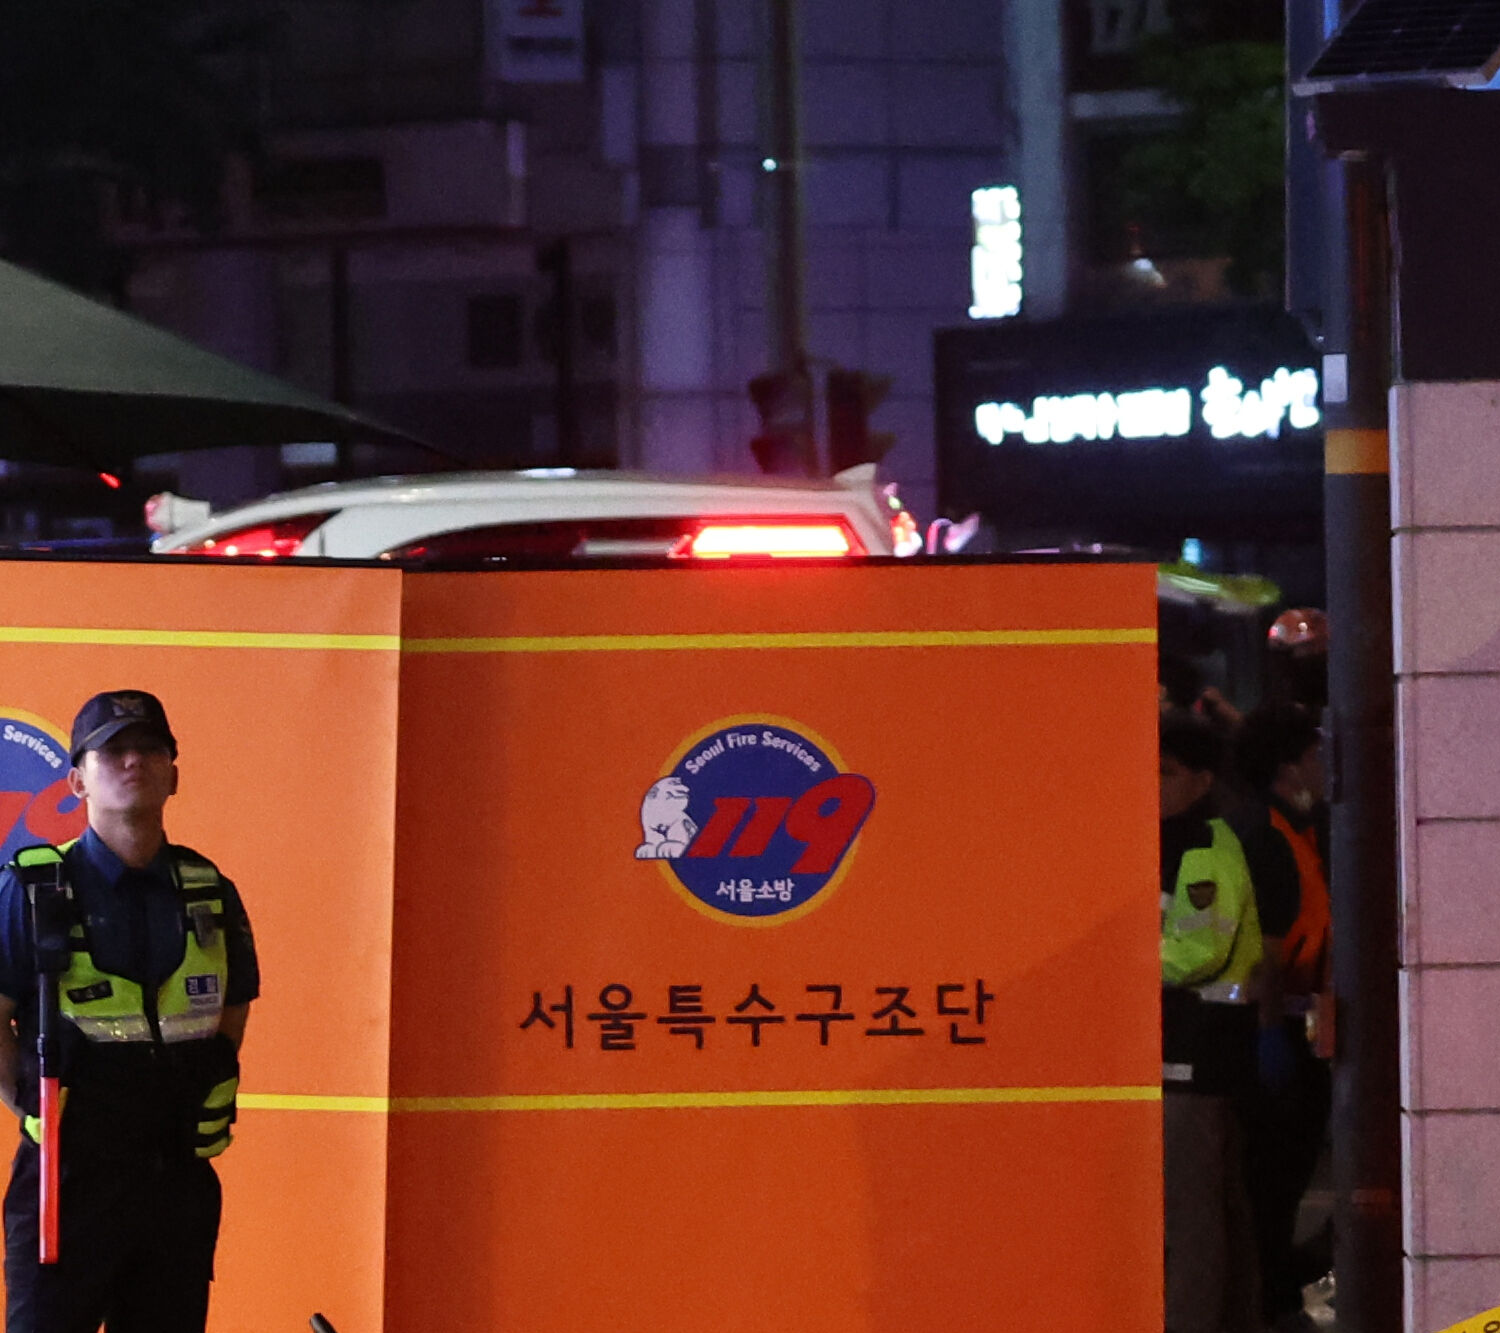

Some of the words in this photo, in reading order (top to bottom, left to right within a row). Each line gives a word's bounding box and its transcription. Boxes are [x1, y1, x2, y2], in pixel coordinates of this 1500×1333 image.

[3, 724, 63, 769] Services
[685, 738, 725, 775] Seoul
[726, 731, 757, 749] Fire
[761, 731, 821, 773] Services
[687, 773, 877, 874] 119
[716, 878, 795, 903] 서울소방
[518, 979, 996, 1051] 서울특수구조단
